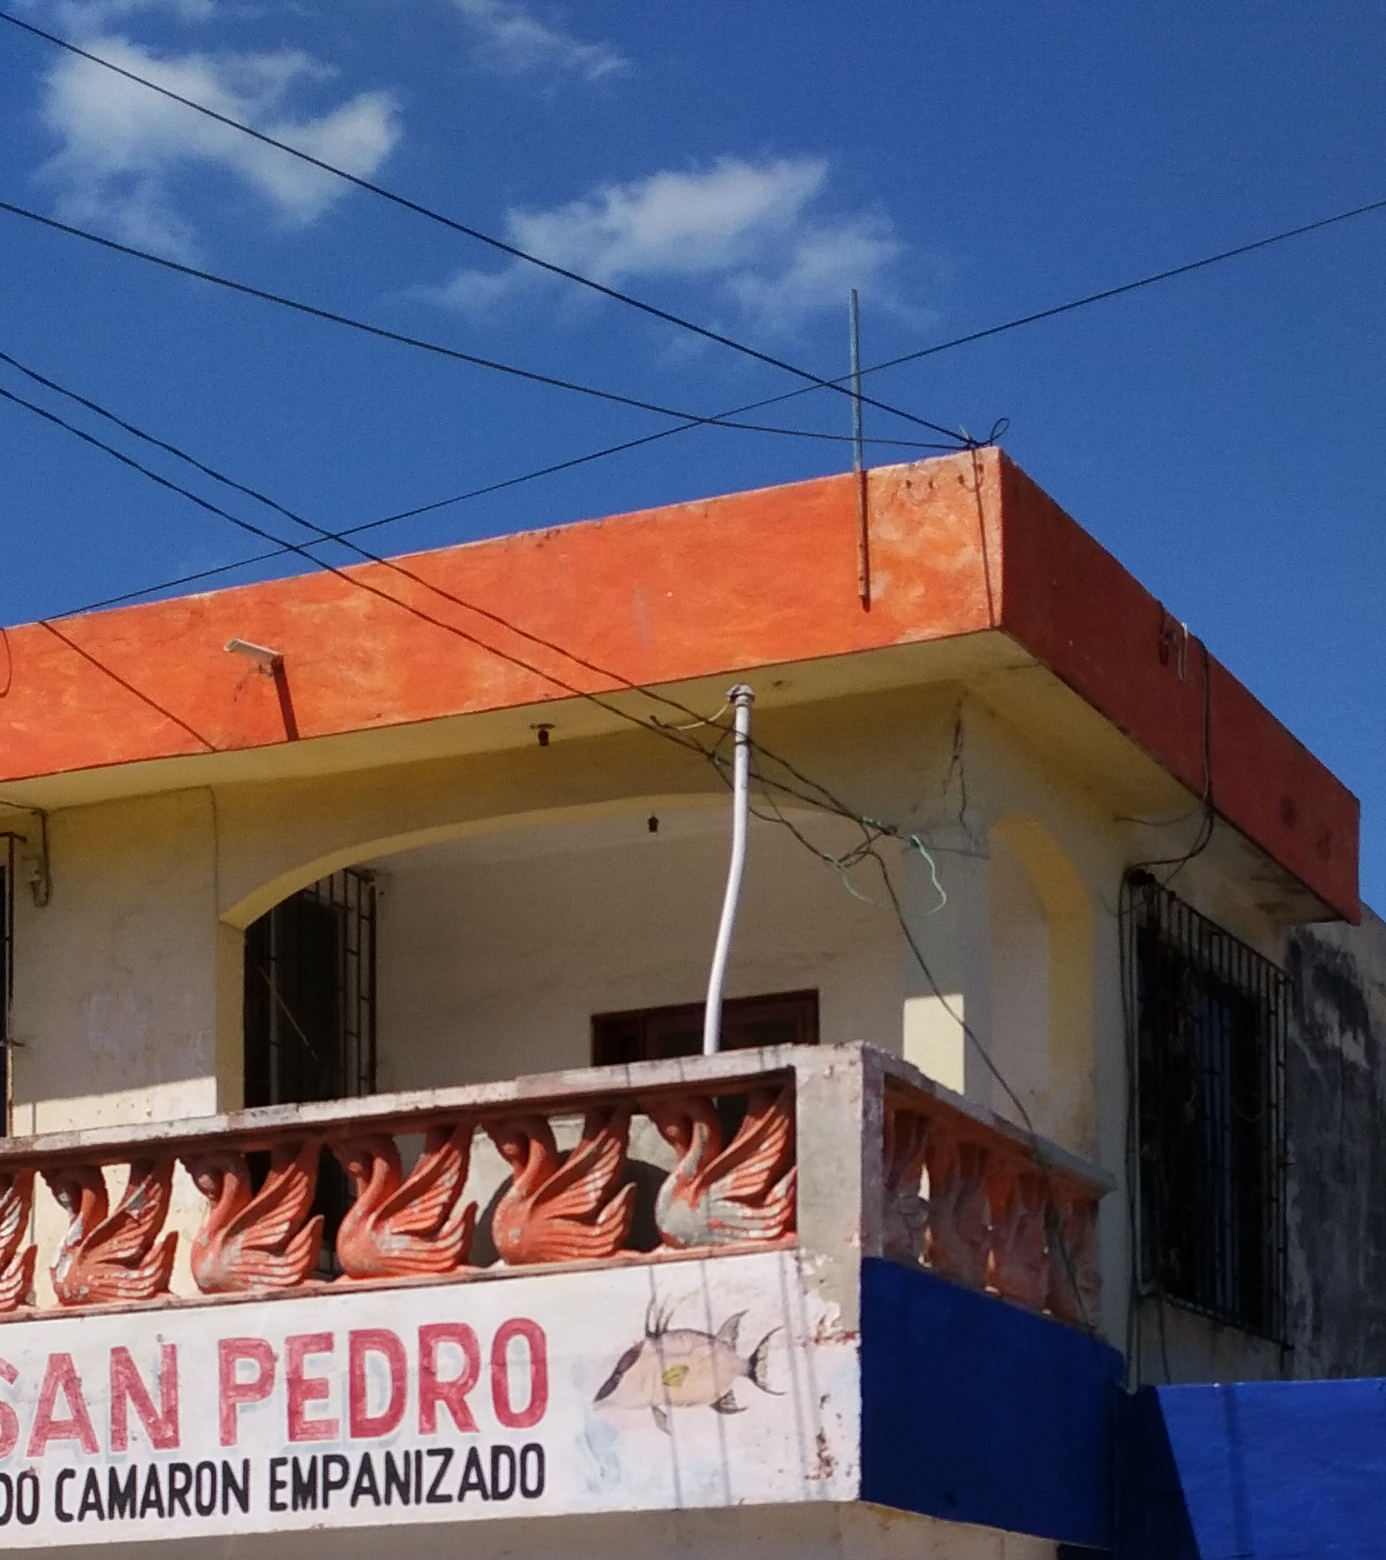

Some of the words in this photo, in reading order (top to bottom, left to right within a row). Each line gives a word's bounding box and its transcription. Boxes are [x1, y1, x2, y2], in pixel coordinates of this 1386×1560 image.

[217, 1316, 550, 1447] PEDRO
[54, 1458, 250, 1523] CAMARON
[269, 1441, 545, 1512] EMPANIZADO
